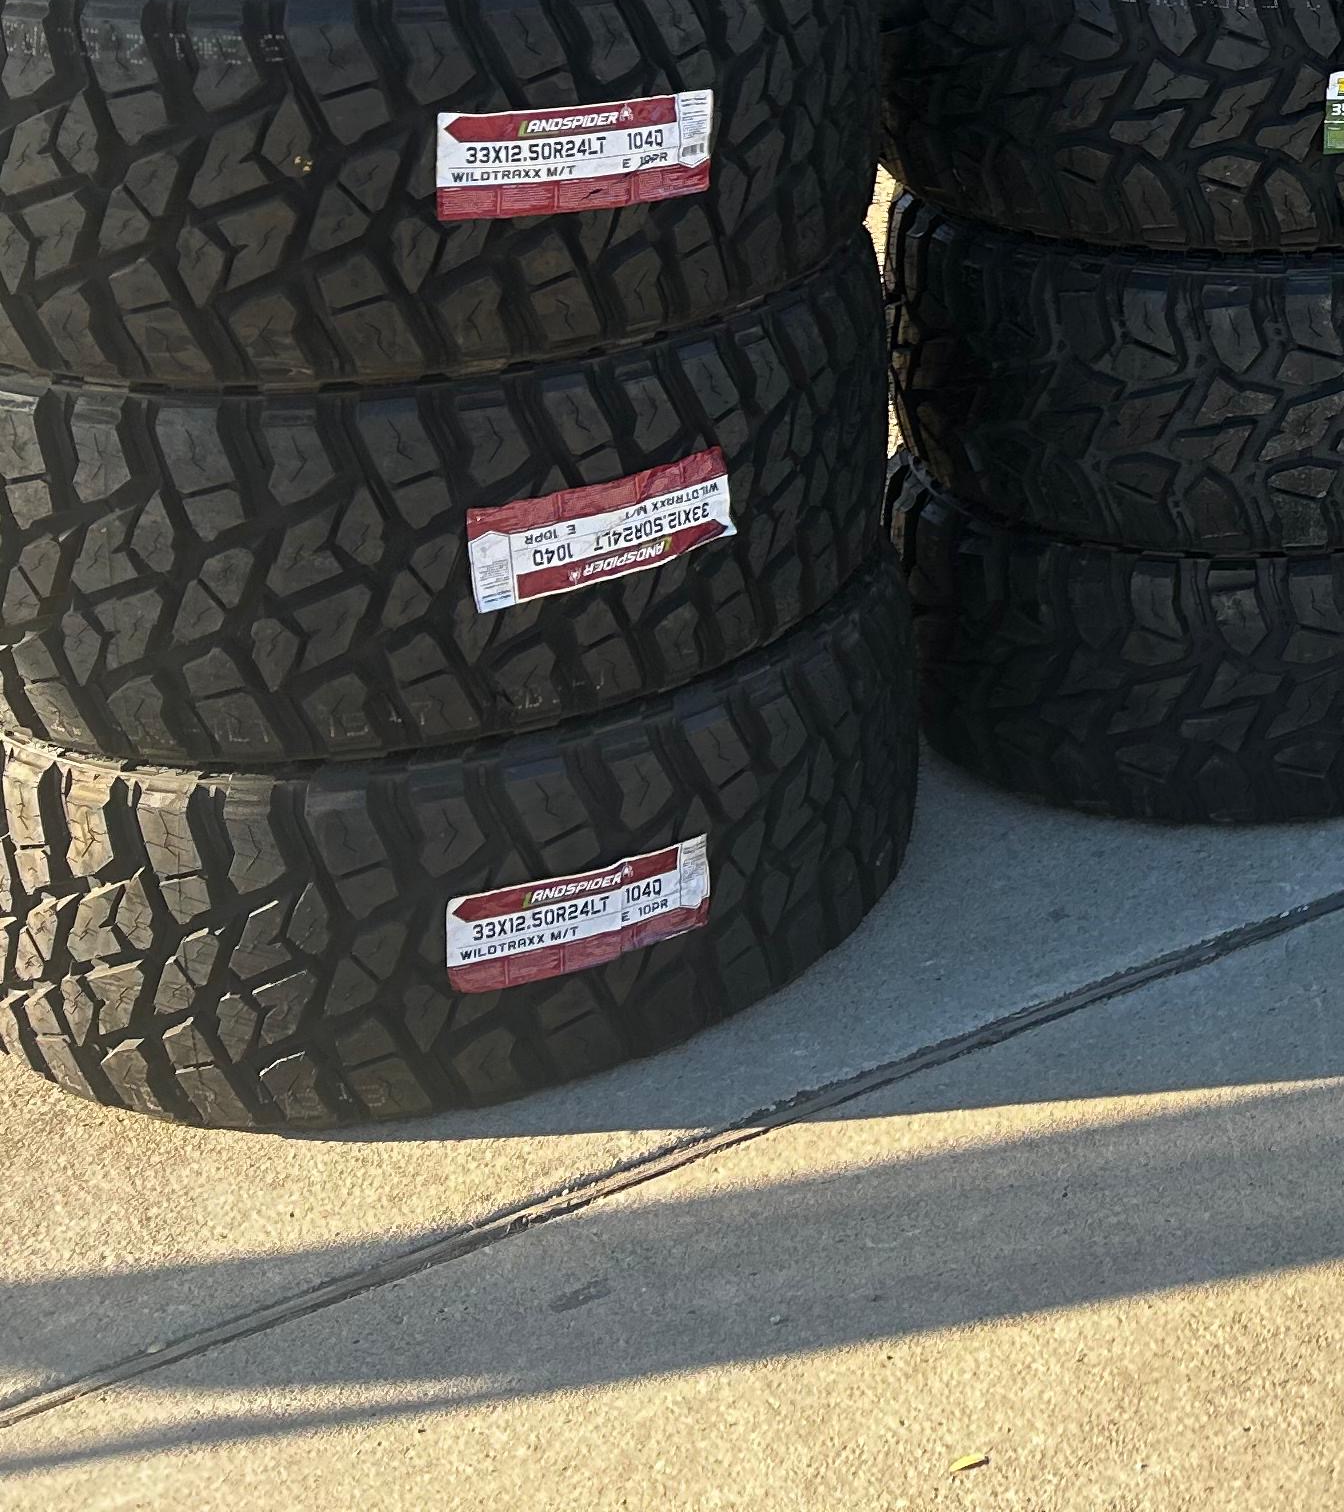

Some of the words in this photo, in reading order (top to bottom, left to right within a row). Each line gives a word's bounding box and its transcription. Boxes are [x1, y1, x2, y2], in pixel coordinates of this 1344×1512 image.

[518, 112, 619, 137] LANDSPIDER
[465, 137, 607, 164] 33X12.50R24LT
[451, 168, 541, 183] WILDTRAXX
[547, 165, 576, 176] M/T
[622, 158, 631, 168] E
[652, 481, 719, 512] WILDTRAXX
[524, 527, 560, 545] 10PR
[567, 524, 577, 535] E
[593, 501, 710, 551] 33X12.50R24LT
[522, 873, 623, 908] LANDSPIDER
[460, 934, 545, 961] WILDTRAXX
[550, 925, 579, 942] M/T
[621, 911, 629, 922] E
[639, 899, 669, 917] 10PR
[472, 896, 609, 941] 33X12.50R24LT
